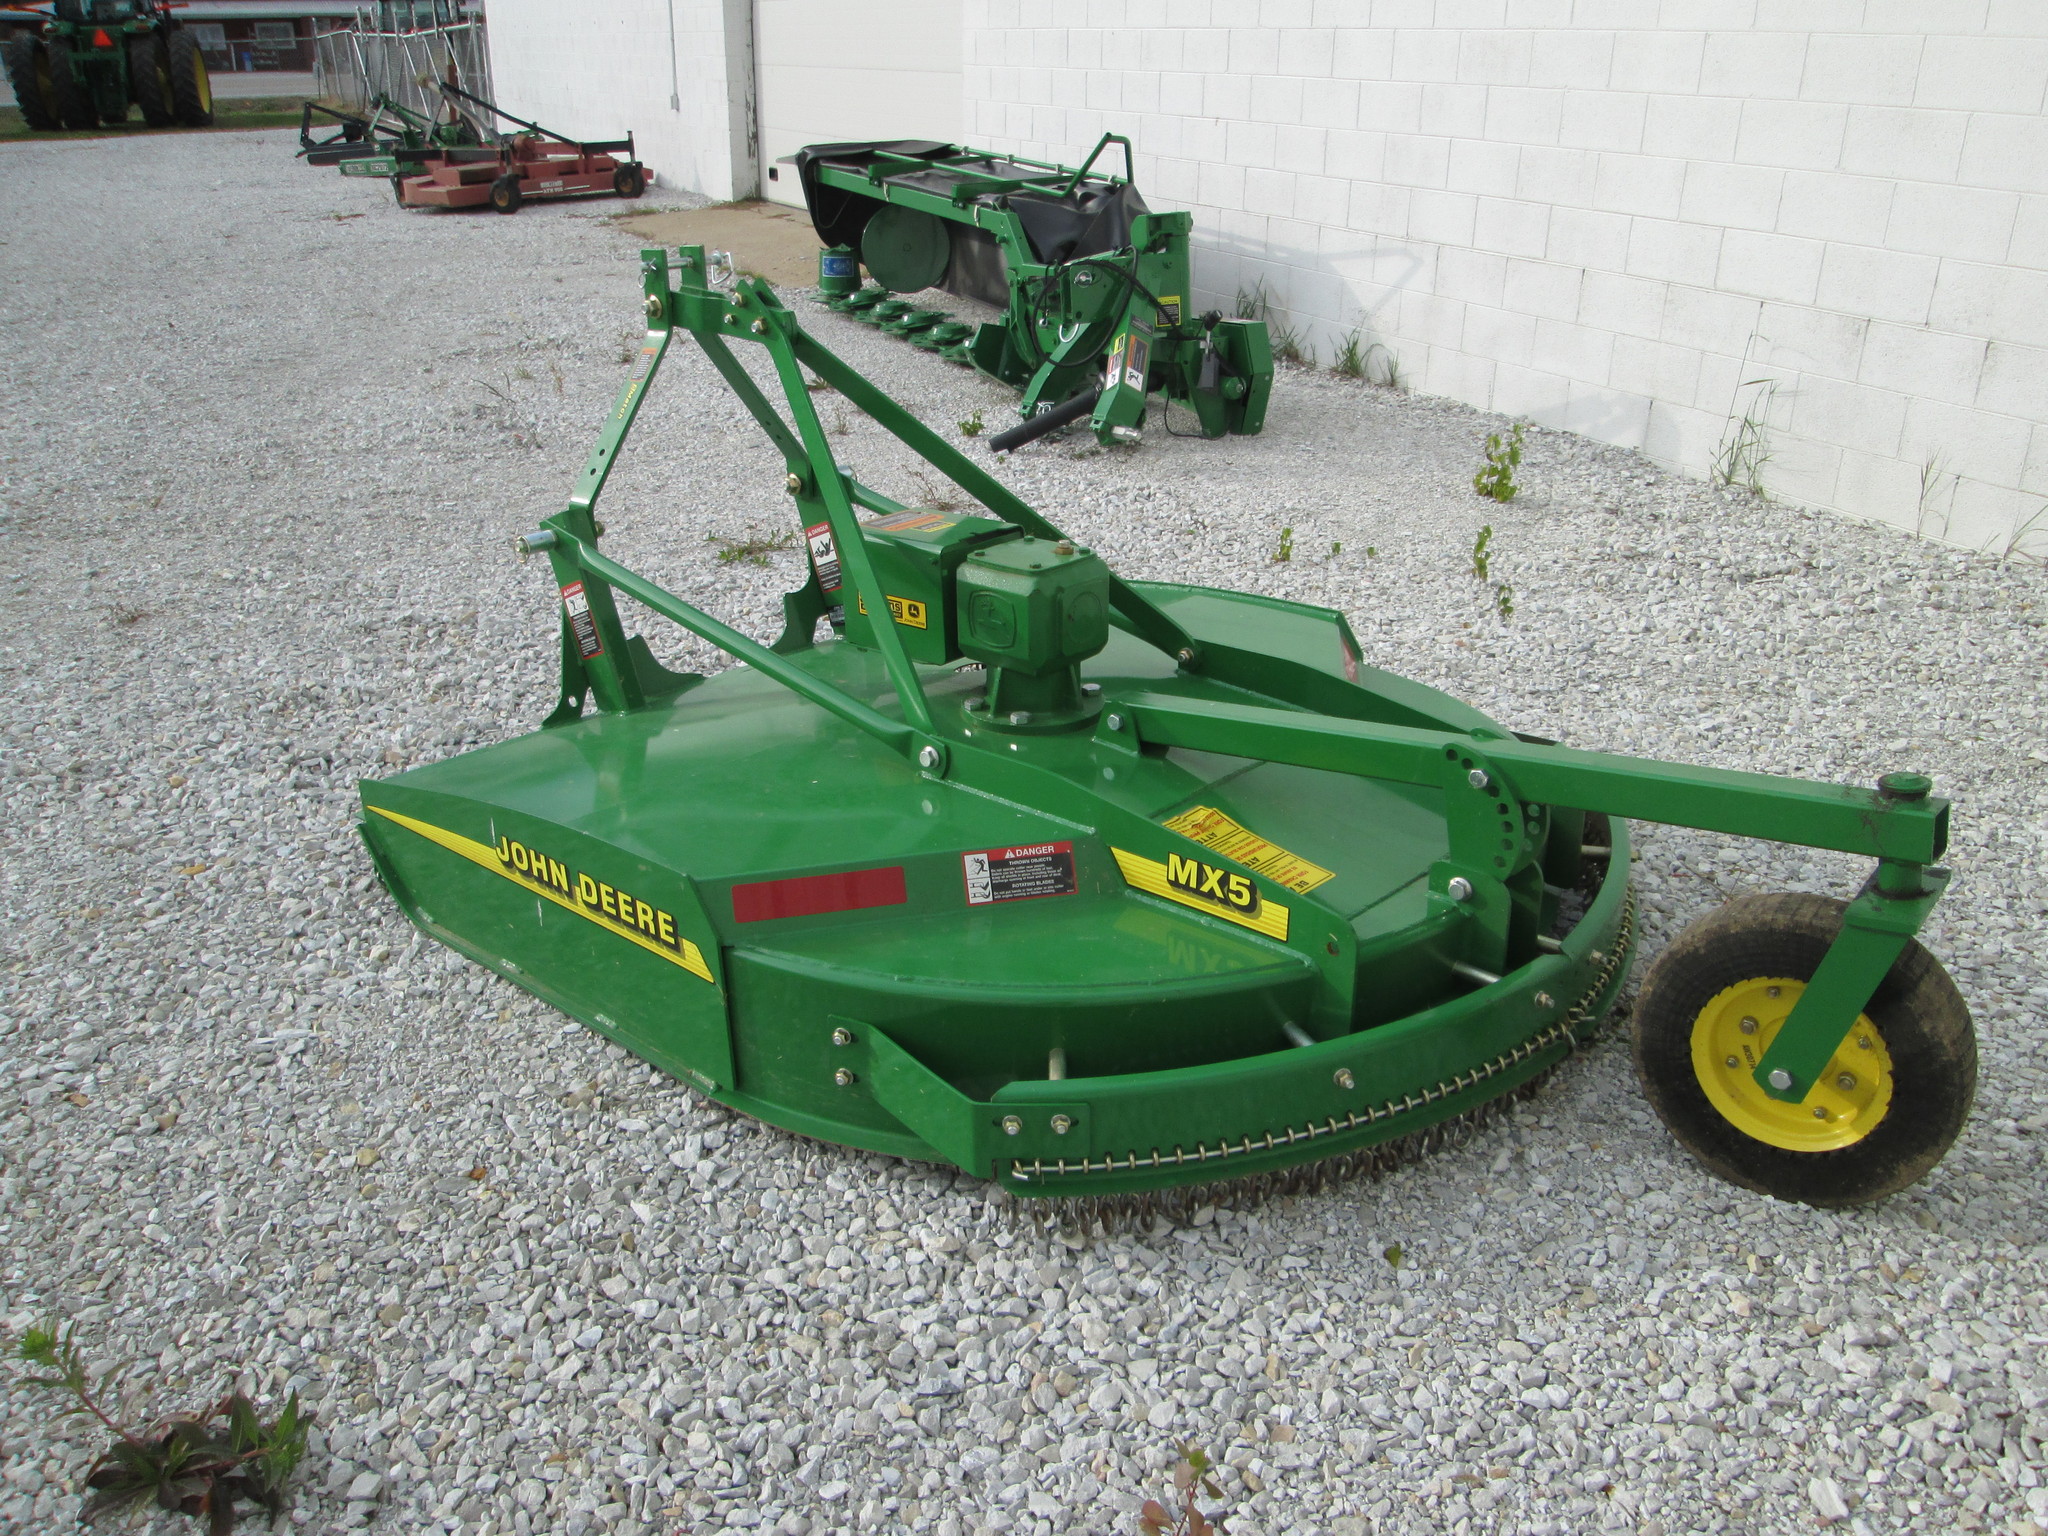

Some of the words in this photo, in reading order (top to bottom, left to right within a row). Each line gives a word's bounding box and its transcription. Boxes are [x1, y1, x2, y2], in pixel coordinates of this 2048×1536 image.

[811, 524, 829, 536] DANGER
[1015, 845, 1055, 857] DANGER
[495, 835, 573, 896] JOHN
[578, 871, 678, 949] DEERE
[1167, 851, 1256, 912] MX5
